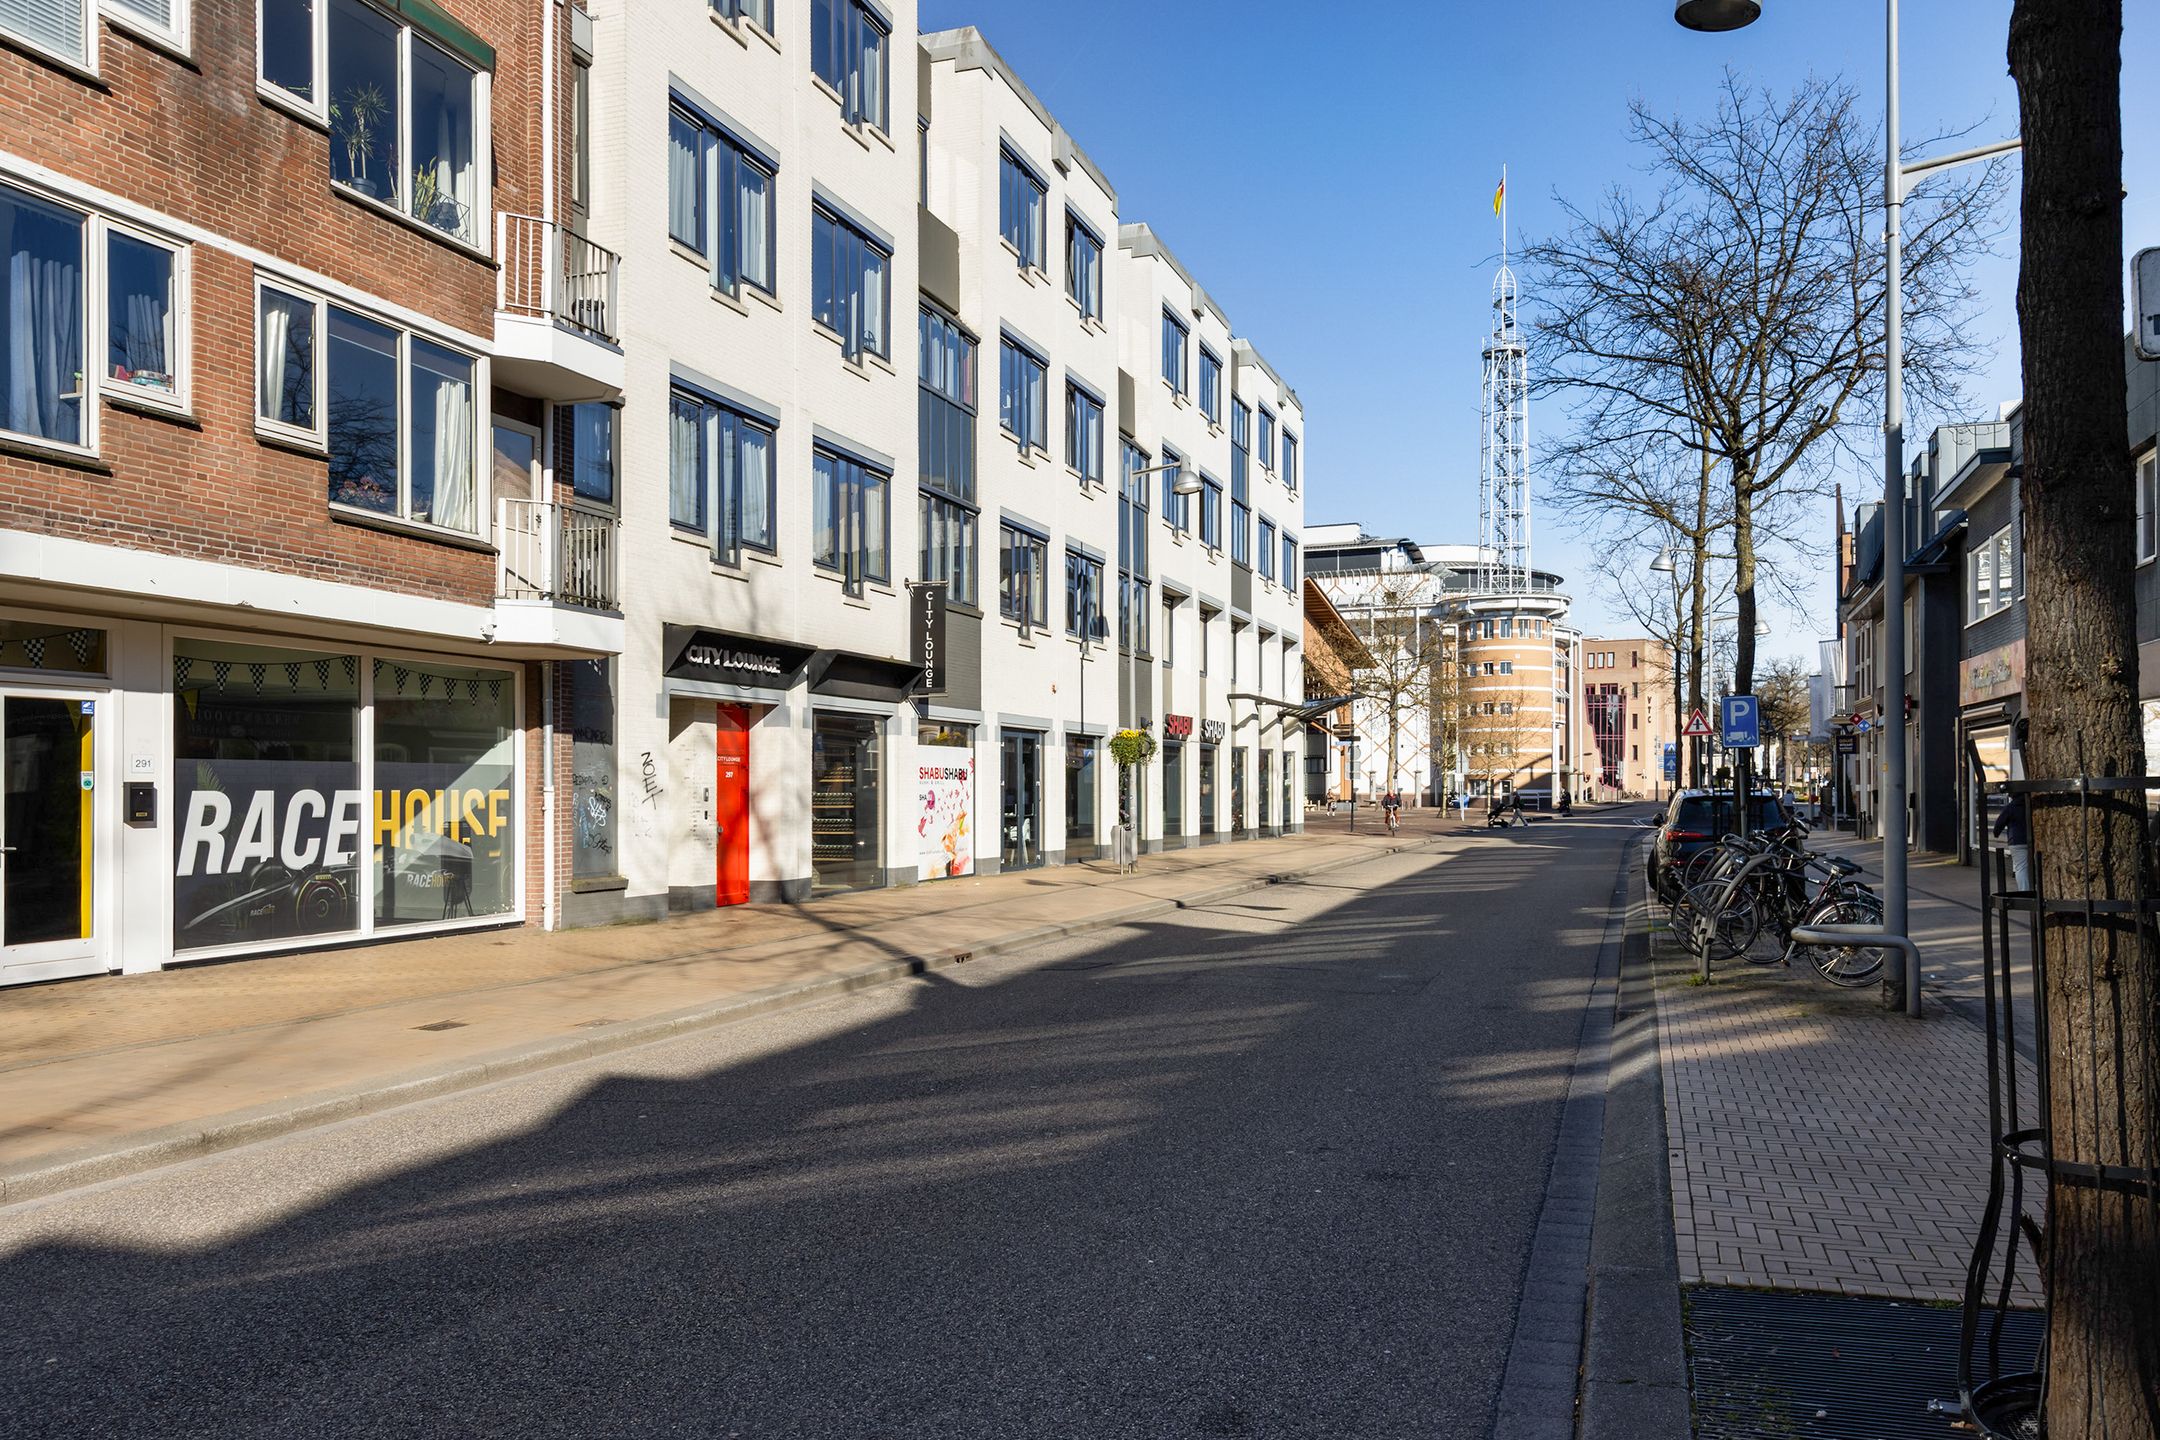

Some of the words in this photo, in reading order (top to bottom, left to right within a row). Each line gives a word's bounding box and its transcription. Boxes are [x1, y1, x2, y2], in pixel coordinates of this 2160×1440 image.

[925, 591, 934, 629] CITY
[925, 631, 934, 688] LOUNGE
[1168, 714, 1193, 735] SHABU
[1204, 719, 1226, 739] SHABU
[1730, 700, 1750, 727] P
[135, 759, 151, 768] 291
